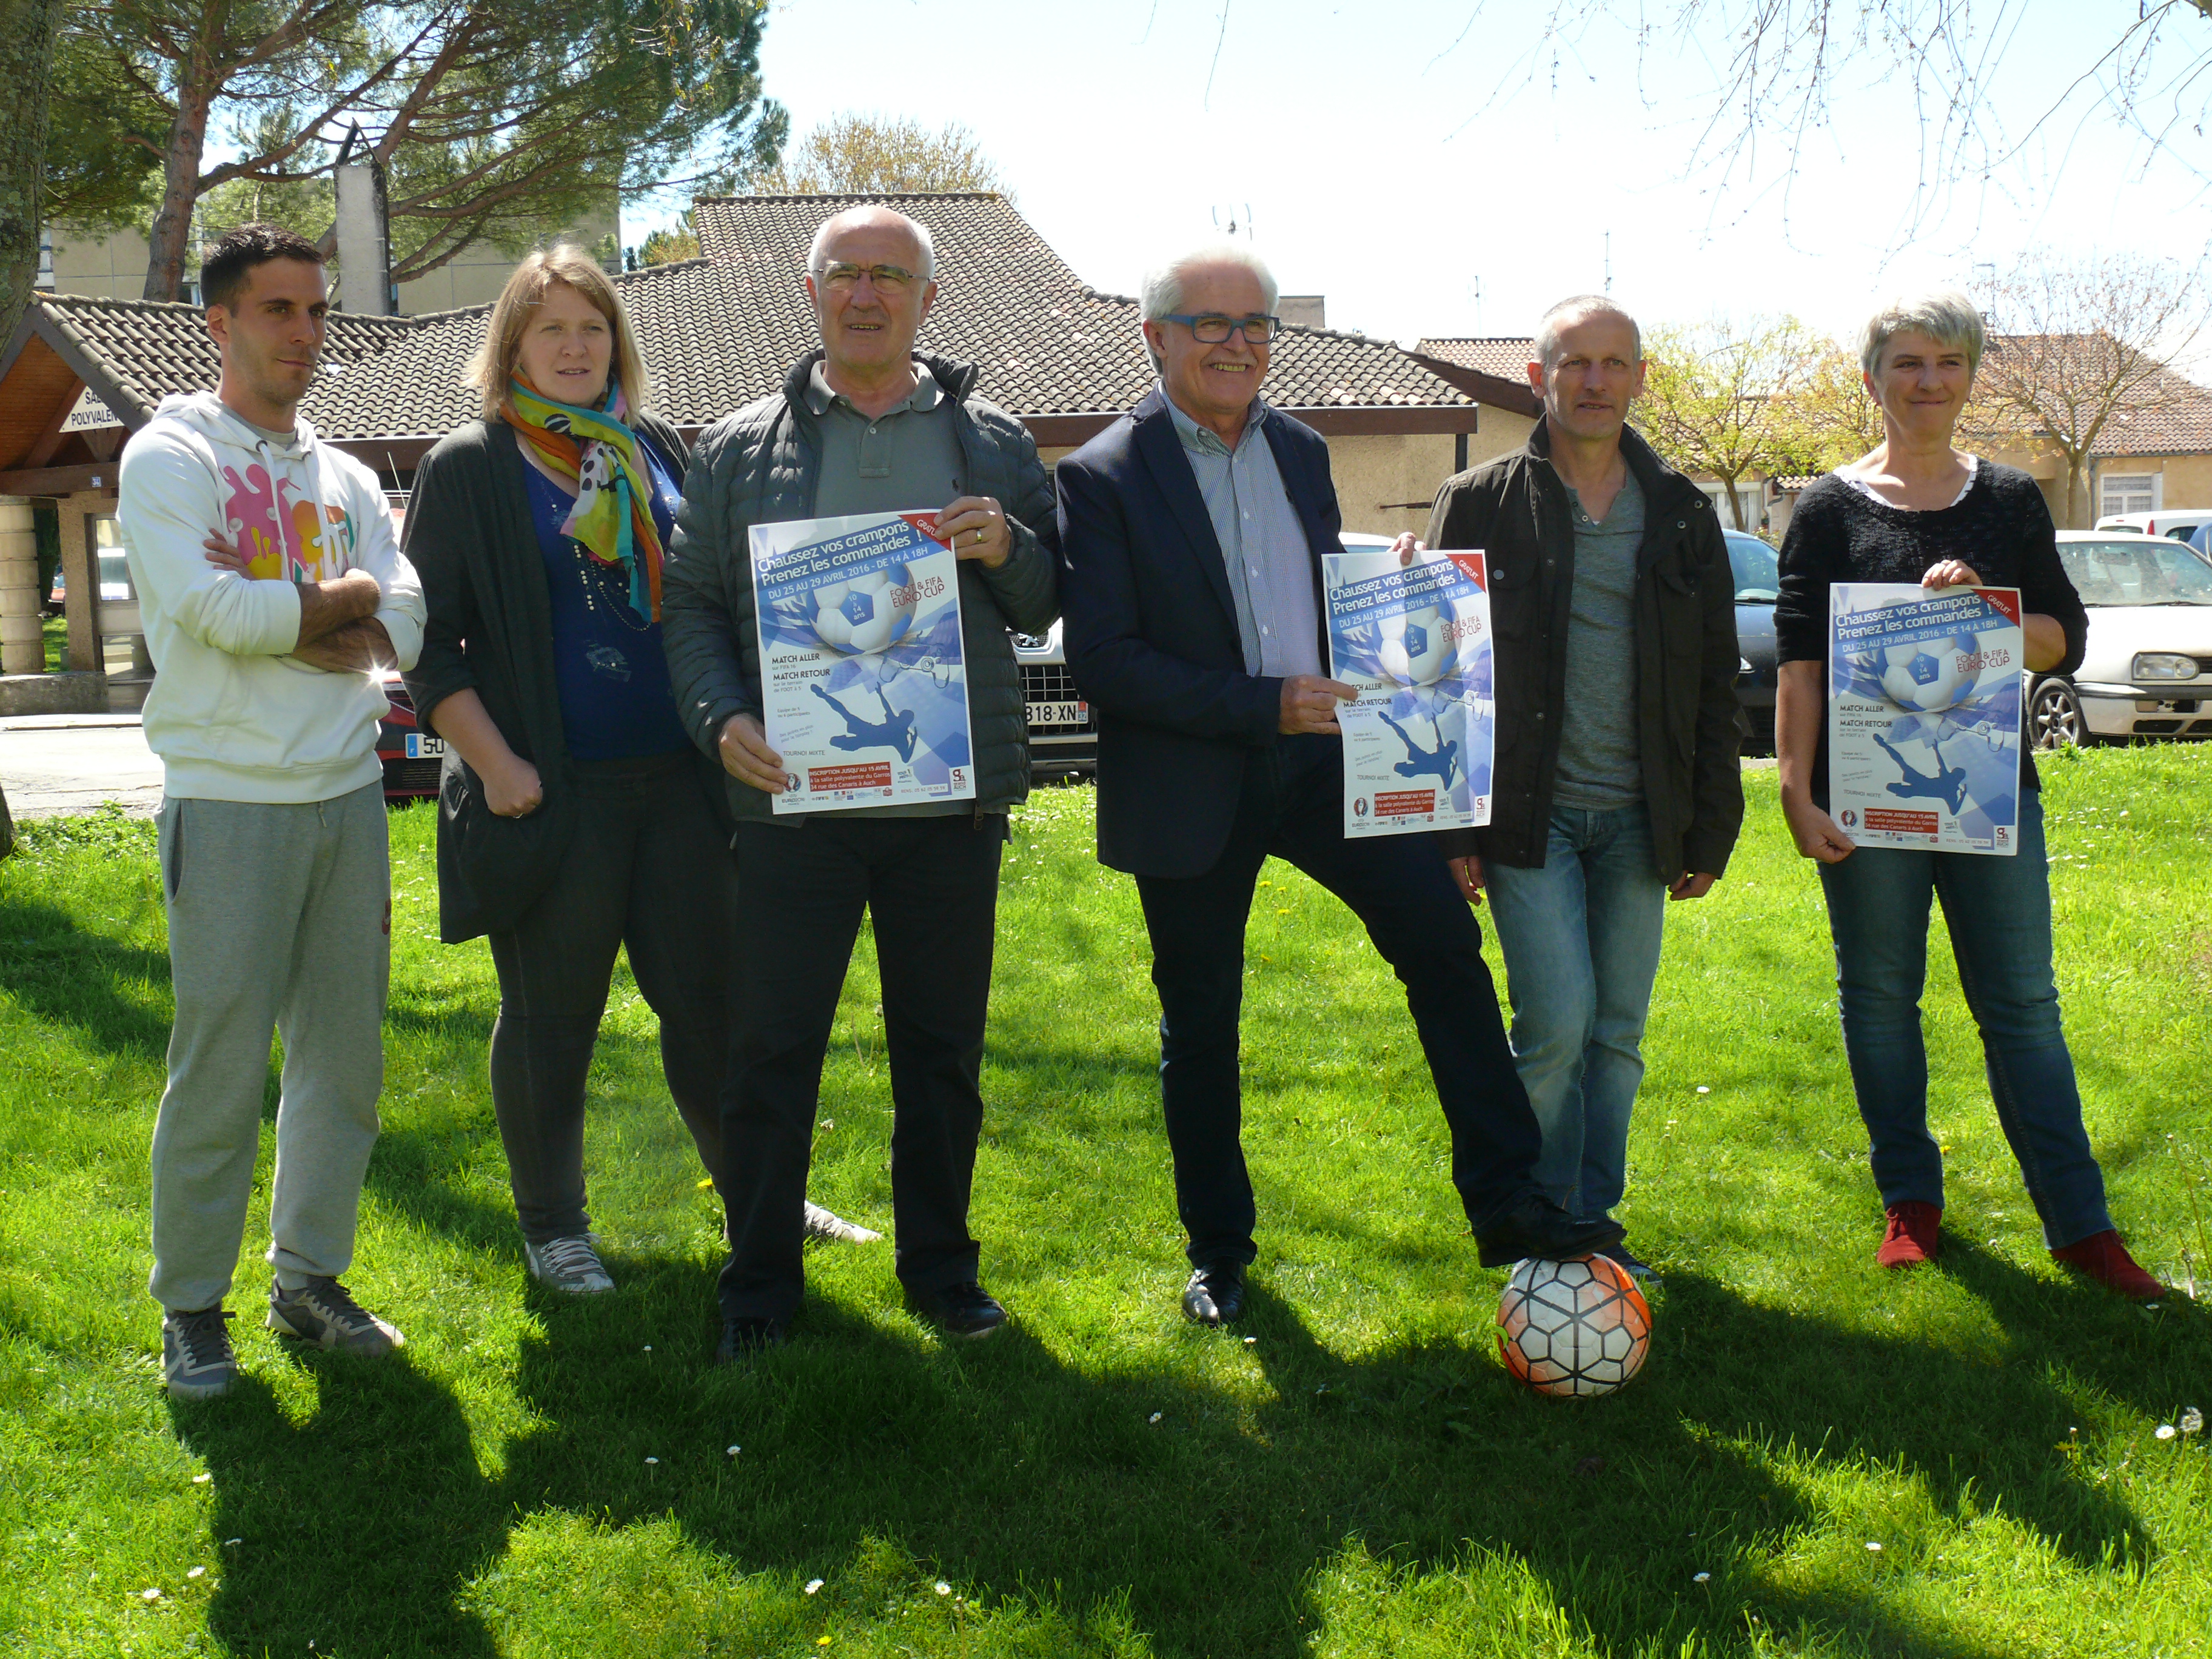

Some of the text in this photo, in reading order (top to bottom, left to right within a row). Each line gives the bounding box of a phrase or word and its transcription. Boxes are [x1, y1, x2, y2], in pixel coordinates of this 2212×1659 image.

[758, 522, 910, 572] Chaussez vos crampons
[761, 529, 923, 586] Prenez les commandes !
[768, 588, 781, 600] DU
[783, 585, 794, 595] 25
[796, 581, 808, 592] AU
[809, 578, 821, 588] 29
[822, 571, 847, 585] AVRIL
[848, 565, 870, 577] 2016
[876, 560, 888, 569] DE
[891, 556, 901, 566] 14
[902, 551, 910, 561] À
[911, 547, 928, 558] 18H
[1330, 561, 1454, 601] Chaussez vos crampons
[1459, 560, 1479, 579] GRATUIT
[890, 583, 916, 598] FOOT
[926, 575, 943, 586] FIFA
[893, 585, 945, 608] EURO CUP
[1333, 569, 1464, 615] Prenez les commandes !
[853, 612, 865, 620] ans
[1339, 618, 1350, 628] DU
[1362, 612, 1373, 622] AU
[1386, 603, 1405, 615] AVRIL
[1406, 600, 1424, 610] 2016
[1430, 595, 1439, 603] DE
[1441, 591, 1449, 600] 14
[1450, 588, 1455, 598] À
[1456, 586, 1469, 595] 18H
[1836, 594, 1980, 627] Chaussez vos crampons
[1987, 595, 2012, 615] GRATUIT
[1441, 621, 1461, 632] FOOT
[1468, 616, 1480, 625] FIFA
[1443, 623, 1481, 642] EURO CUP
[1837, 603, 1992, 640] Prenez les commandes !
[1842, 643, 1854, 652] DU
[1868, 639, 1880, 648] AU
[1882, 637, 1892, 645] 29
[1894, 633, 1916, 644] AVRIL
[1919, 630, 1939, 640] 2016
[1946, 626, 1957, 635] DE
[1960, 624, 1971, 632] 14
[1972, 620, 1979, 631] À
[1981, 620, 1997, 629] 18H
[772, 653, 820, 664] MATCH ALLER
[1956, 649, 2008, 663] FOOT & FIFA
[1958, 656, 2009, 673] EURO CUP
[773, 669, 830, 680] MATCH RETOUR
[1079, 712, 1086, 720] 32
